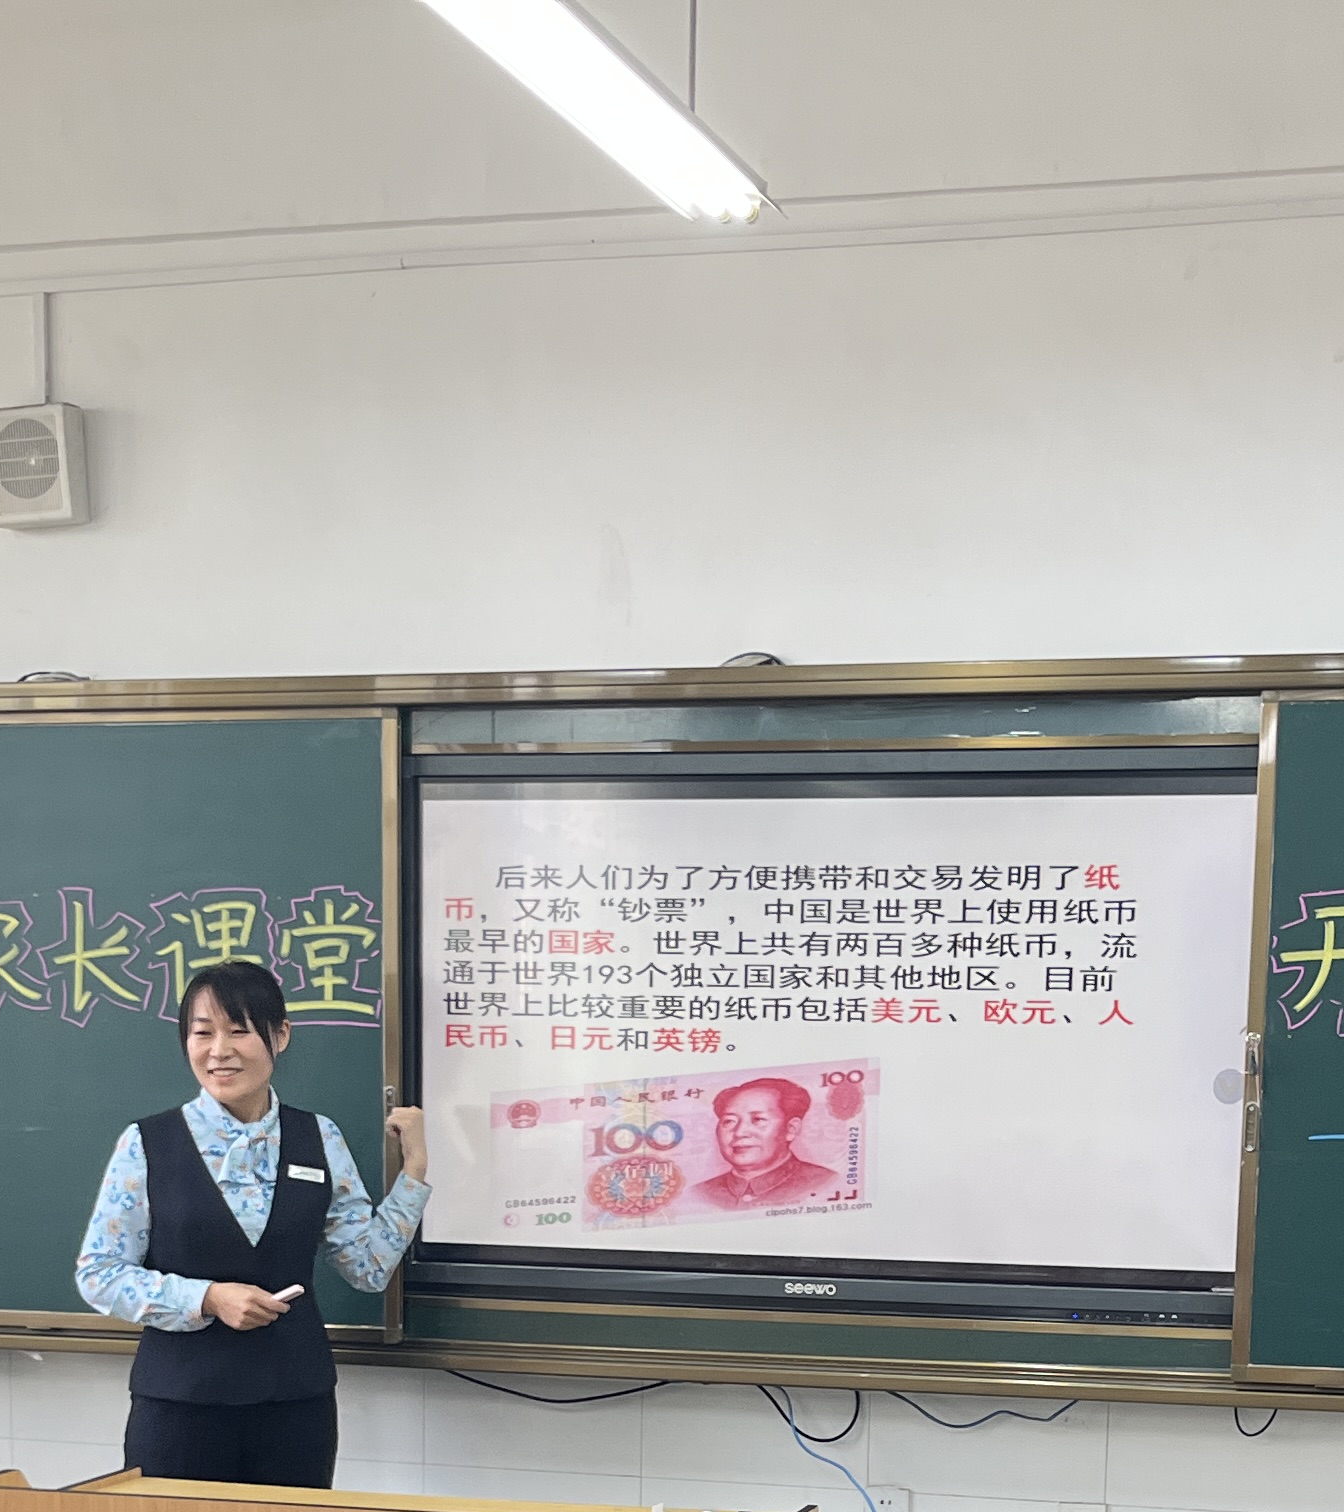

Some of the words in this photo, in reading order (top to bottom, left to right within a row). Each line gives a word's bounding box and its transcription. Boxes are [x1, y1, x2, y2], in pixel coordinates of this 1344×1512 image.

[494, 864, 1121, 892] 后来人们为了方便携带和交易发明了纸
[442, 992, 1135, 1026] 世界上比较重要的纸币包括美元、欧元、人
[444, 1023, 738, 1054] 民币、日元和英镑。
[820, 1069, 865, 1088] 100
[587, 1120, 684, 1158] 100
[535, 1212, 573, 1227] 100
[784, 1282, 837, 1296] seewo
